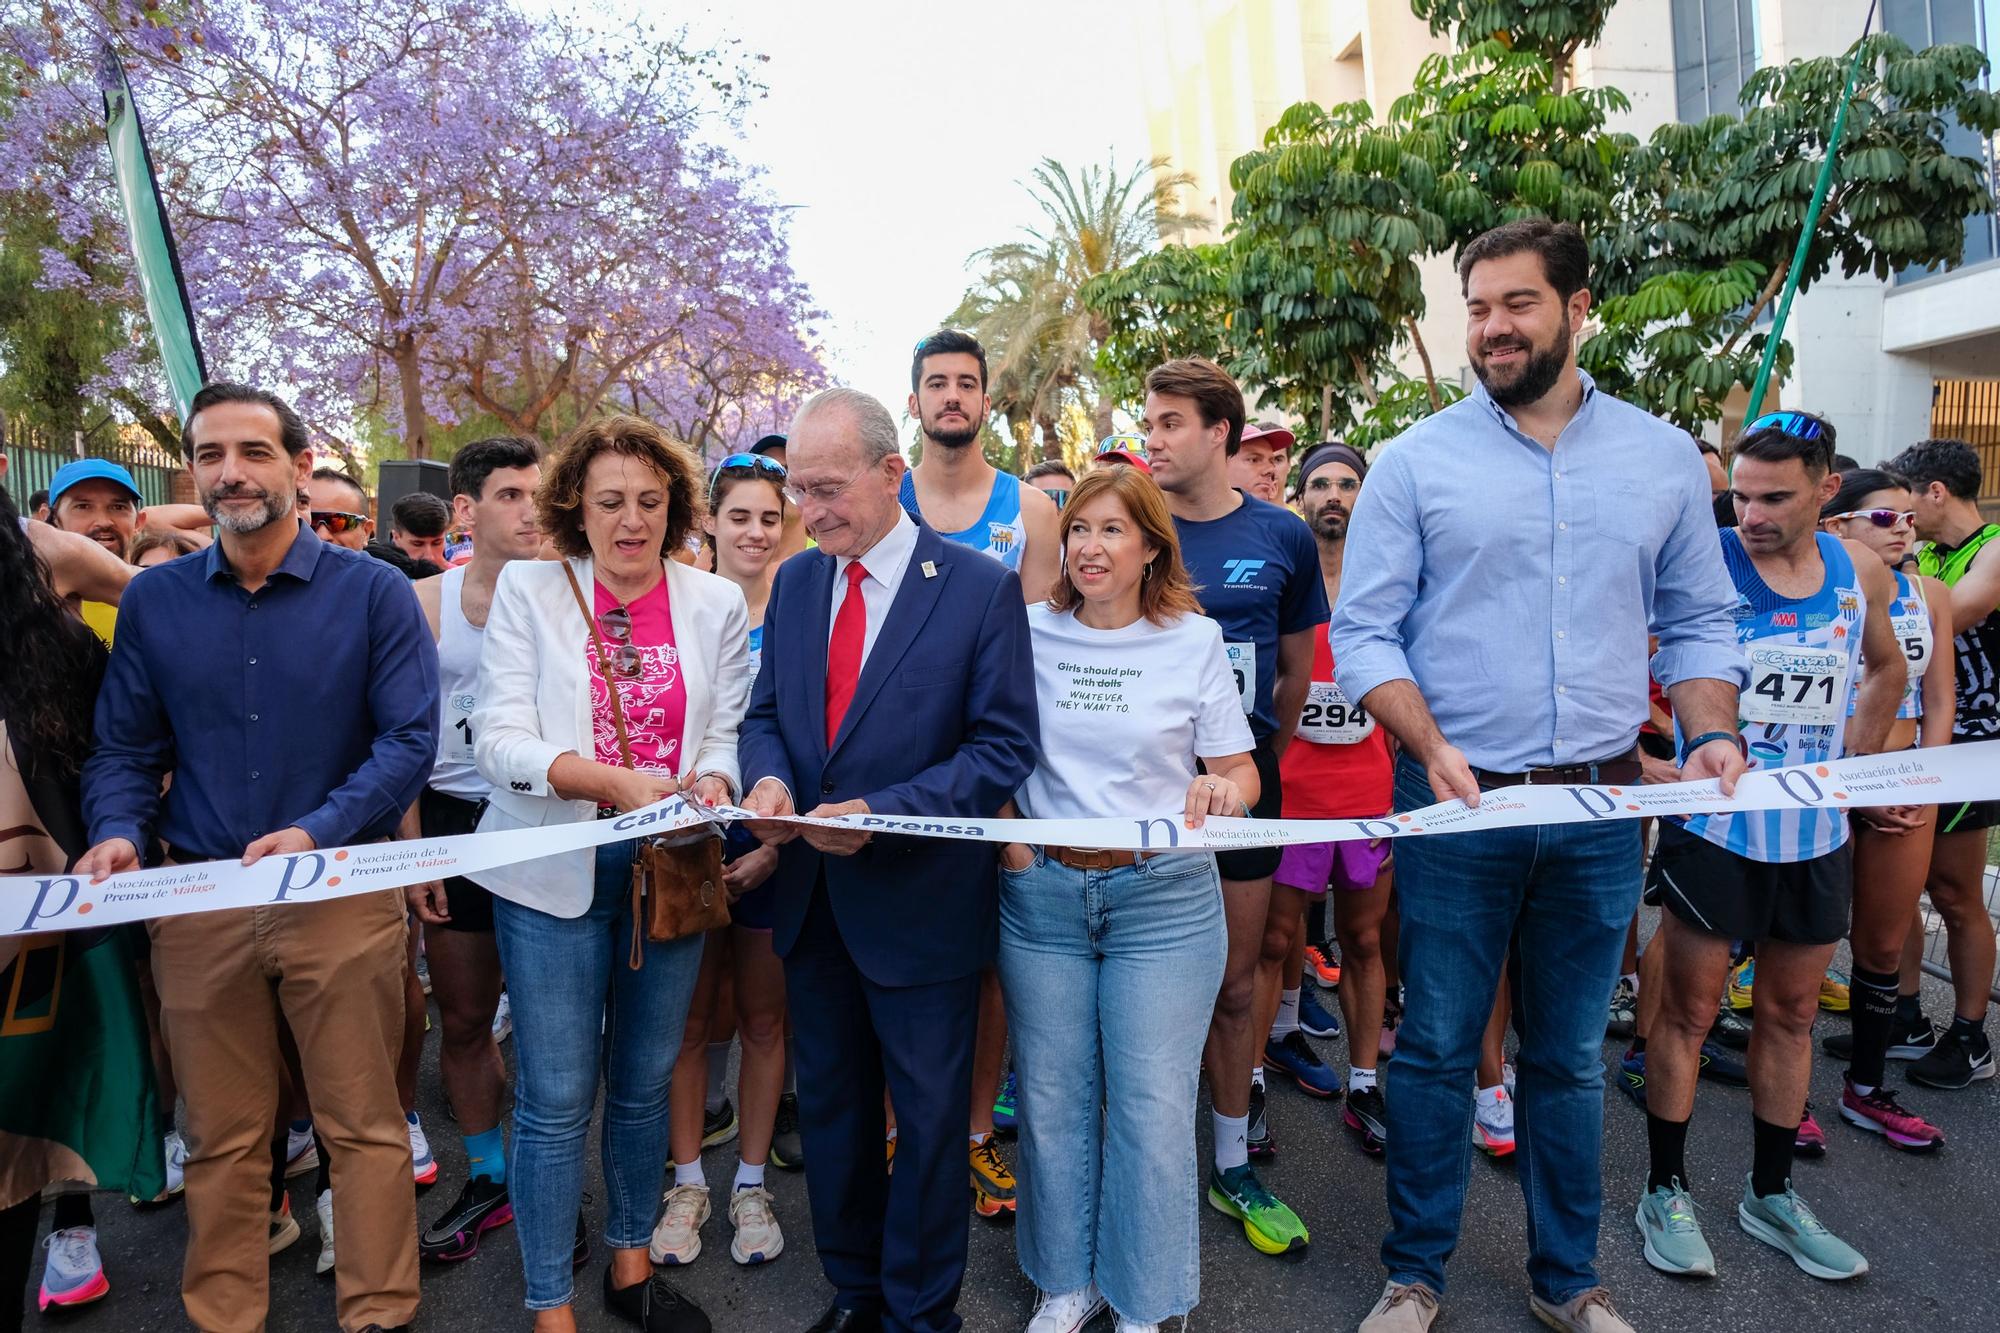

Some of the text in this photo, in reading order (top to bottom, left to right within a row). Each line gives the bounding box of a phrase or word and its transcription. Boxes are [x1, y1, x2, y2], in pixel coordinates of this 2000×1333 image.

[1057, 662, 1143, 678] Girls should play
[1072, 677, 1123, 688] with dolls
[1755, 673, 1834, 704] 471
[1056, 700, 1079, 710] THEY
[1084, 702, 1112, 712] WANT
[1070, 691, 1123, 702] WHATEVER
[1302, 704, 1367, 727] 294
[1839, 762, 1924, 782] Asociación de la
[1845, 774, 1943, 793] Prensa de Málaga
[1632, 790, 1689, 799] Asociación
[1421, 794, 1508, 822] Asociaci de la
[1425, 801, 1527, 828] Prensa de Málaga
[861, 817, 985, 836] Prensa
[1202, 828, 1289, 839] Asociación de la
[353, 846, 449, 865] Asociación de la
[350, 857, 457, 877] Prensa de Málaga
[107, 872, 209, 890] Asociación de la
[103, 882, 216, 903] Prensa de Málaga
